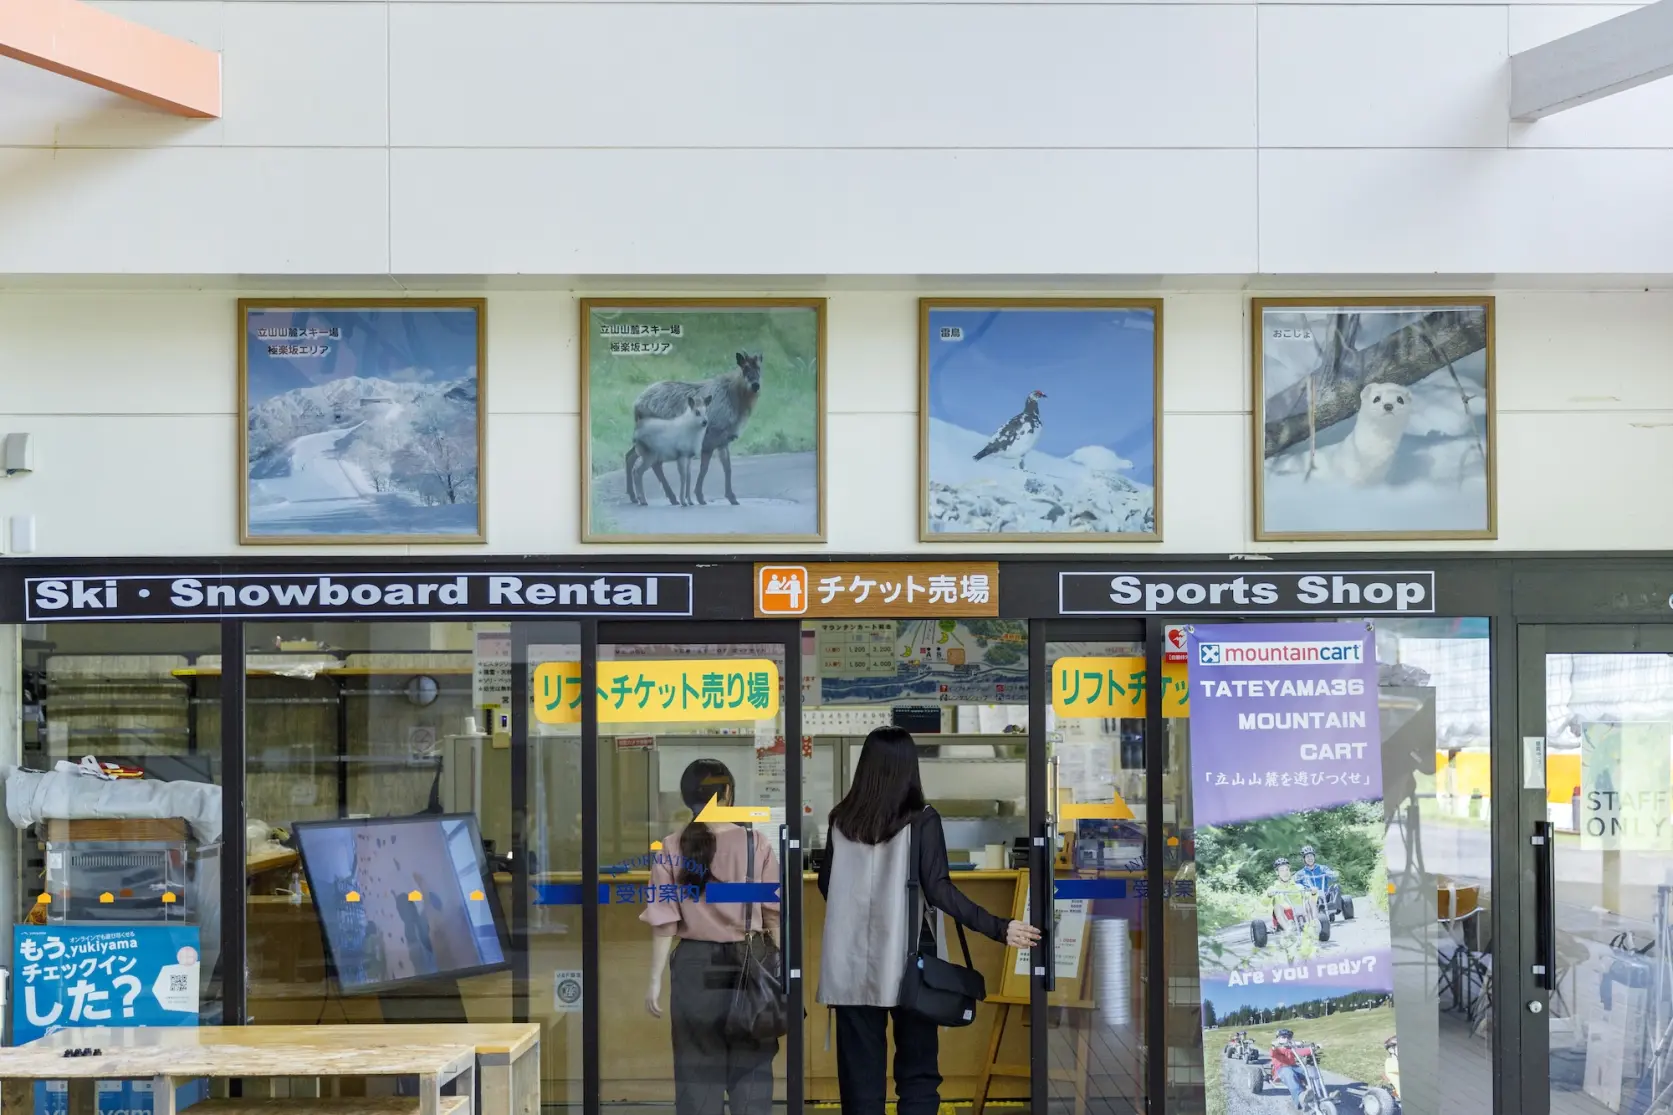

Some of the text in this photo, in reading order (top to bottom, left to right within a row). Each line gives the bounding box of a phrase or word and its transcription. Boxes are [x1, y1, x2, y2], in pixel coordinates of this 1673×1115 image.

[258, 327, 341, 339] 立山山麓スキー場
[600, 325, 682, 337] 立山山麓スキー場
[1272, 328, 1311, 339] おこじょ
[267, 344, 331, 357] 極楽坂エリア
[610, 342, 672, 354] 極楽坂エリア
[36, 580, 117, 609] Ski
[170, 577, 468, 607] Snowboard
[489, 576, 658, 606] Rental
[817, 574, 990, 604] チケット売場
[1109, 576, 1426, 611] Sports Shop
[1224, 644, 1361, 662] mountaincart
[1200, 679, 1364, 697] TATEYAMA36
[1238, 711, 1367, 730] MOUNTAIN
[1300, 742, 1368, 760] CART
[1586, 791, 1667, 811] STAFF
[1586, 817, 1667, 837] ONLY
[616, 884, 700, 904] 受付案内
[70, 938, 138, 958] yukiyama
[22, 955, 138, 984] チェックイン
[1228, 955, 1377, 987] Are you redy?
